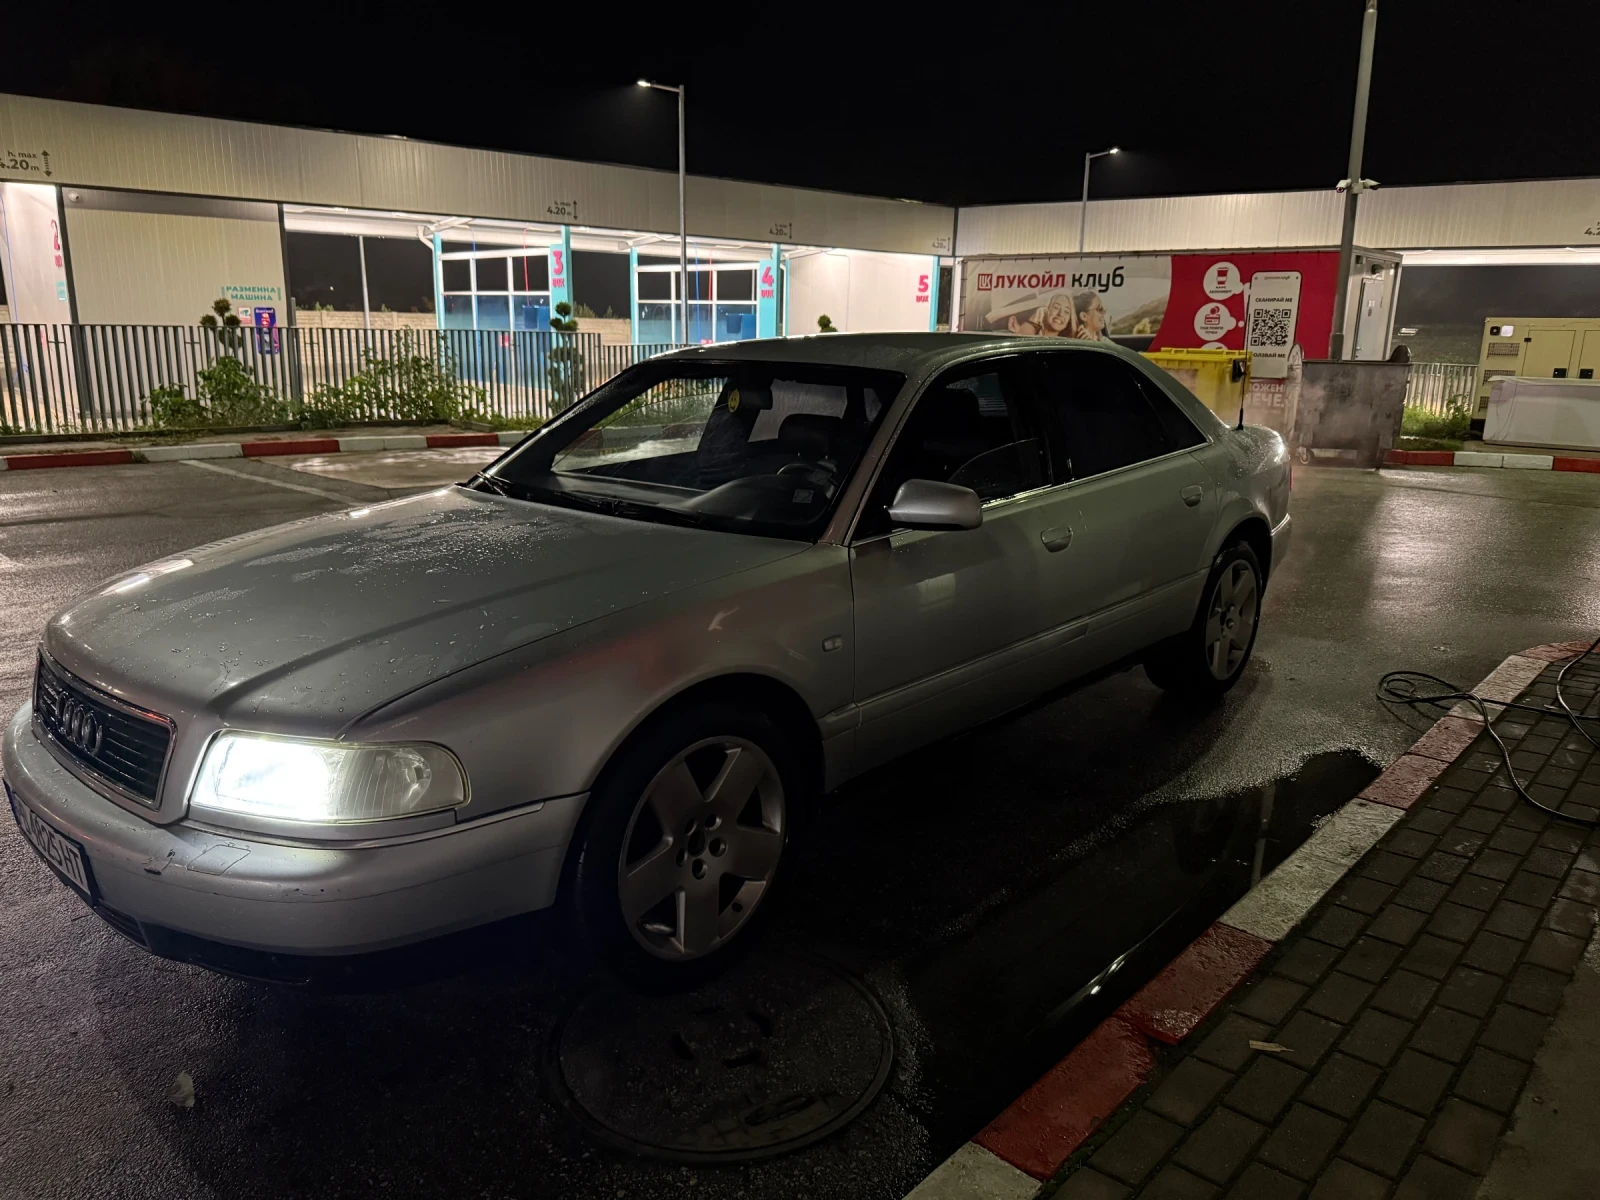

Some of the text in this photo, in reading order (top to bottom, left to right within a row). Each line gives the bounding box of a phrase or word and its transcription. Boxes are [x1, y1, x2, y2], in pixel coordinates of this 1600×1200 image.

[547, 206, 566, 216] 4.20
[51, 219, 60, 250] 2
[769, 227, 784, 236] 4.20
[552, 250, 564, 275] 3
[761, 266, 774, 287] 4
[918, 274, 929, 293] 5
[994, 266, 1125, 293] ЛУКОЙЛ клуб
[231, 293, 273, 301] МАШИНА
[1249, 393, 1285, 408] ЕЧЕ.
